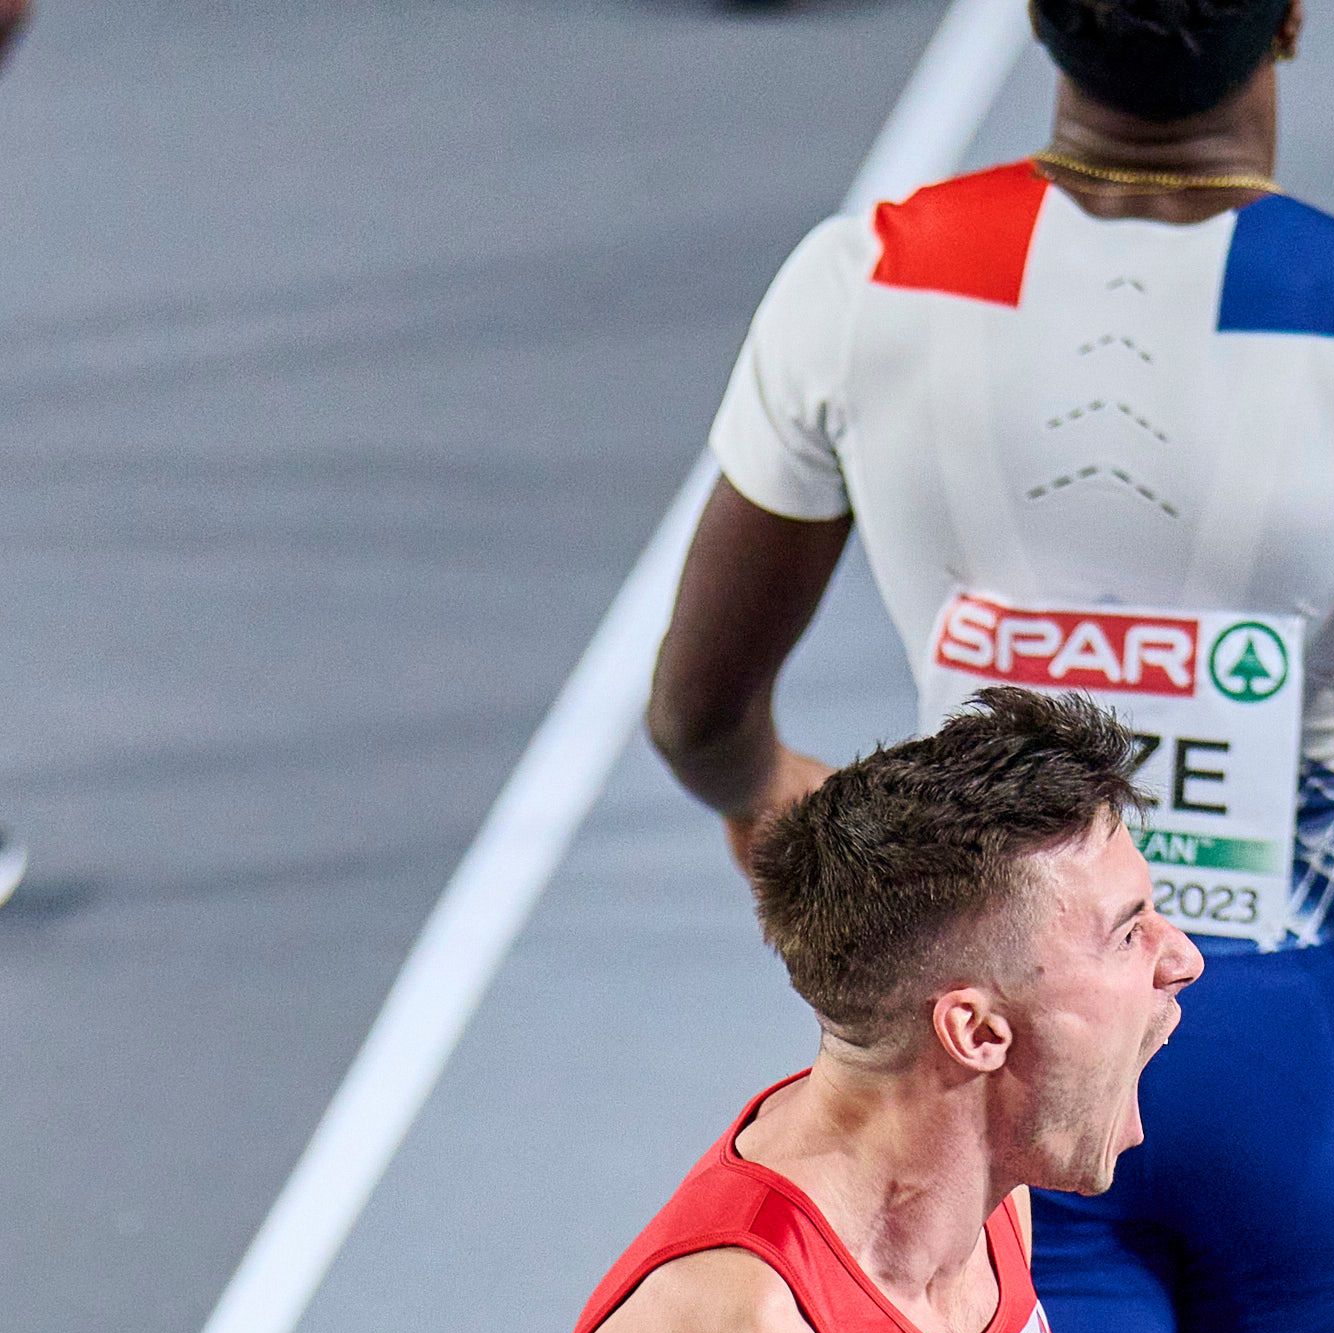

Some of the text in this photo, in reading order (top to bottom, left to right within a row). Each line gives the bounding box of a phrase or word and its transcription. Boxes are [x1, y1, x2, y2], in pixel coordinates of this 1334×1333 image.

[942, 602, 1192, 687] SPAR
[1129, 732, 1231, 815] ZE
[1154, 878, 1258, 923] 2023
